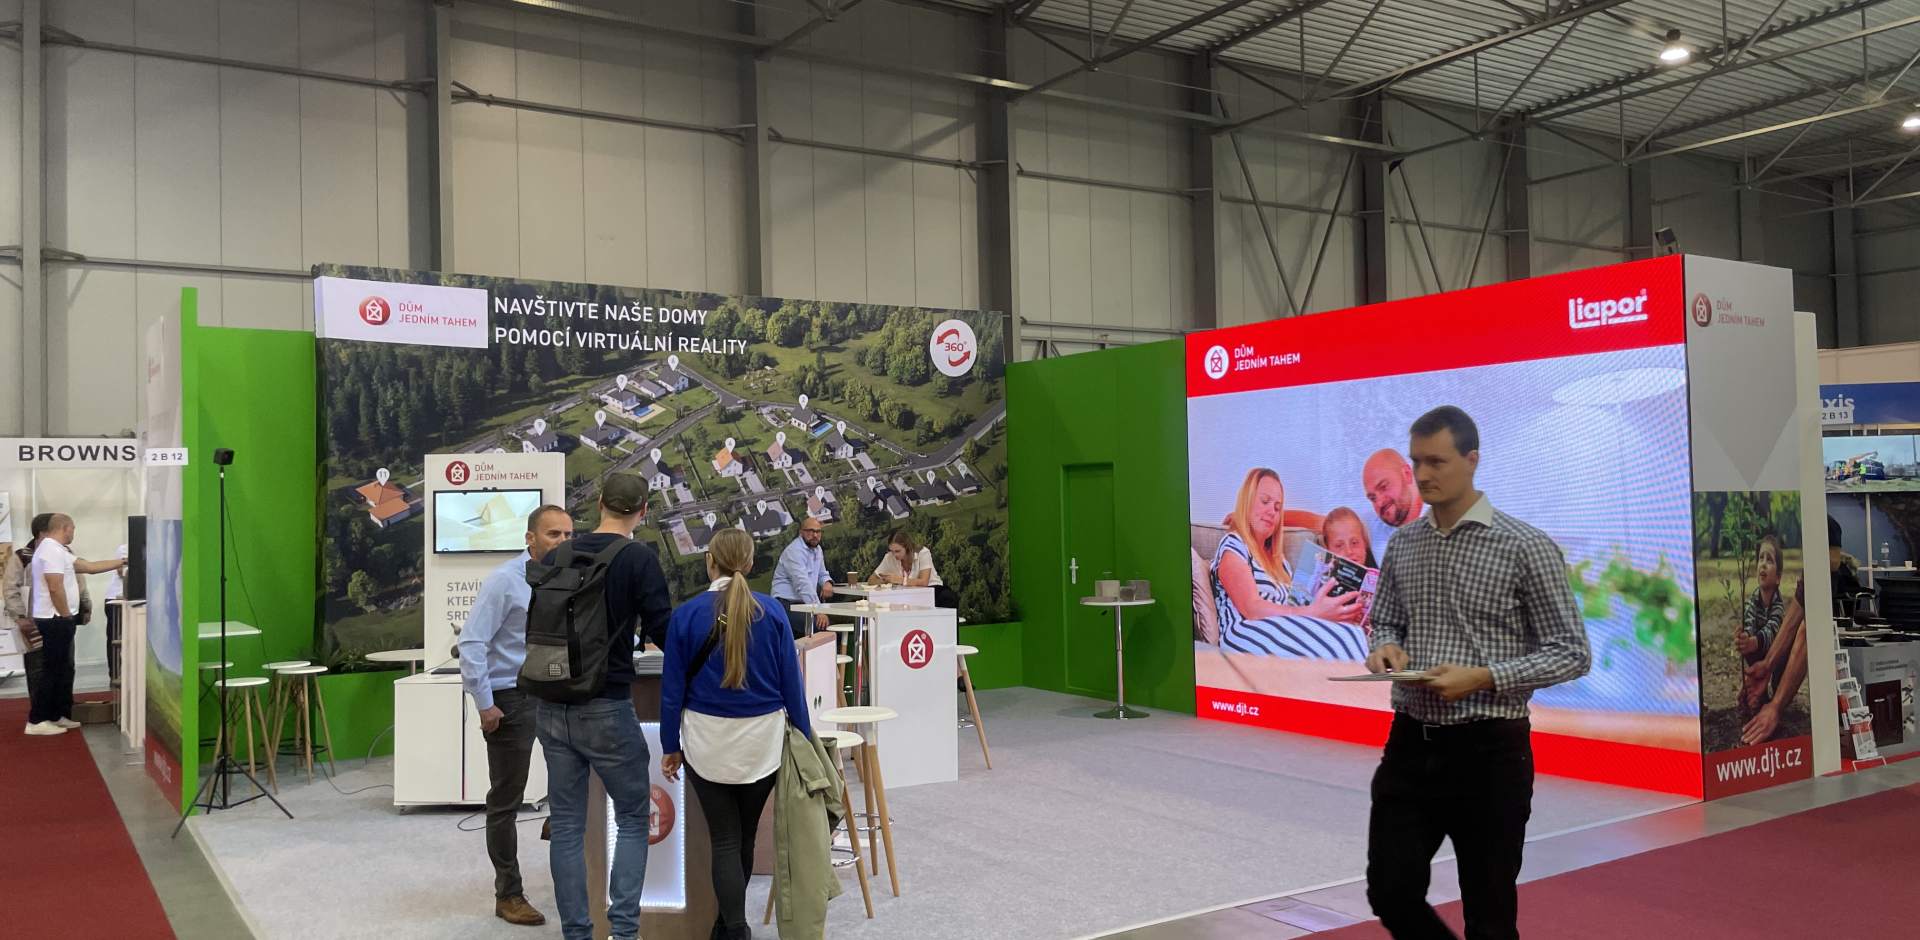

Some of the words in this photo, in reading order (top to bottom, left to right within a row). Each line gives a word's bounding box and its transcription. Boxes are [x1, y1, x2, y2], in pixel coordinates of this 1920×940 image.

[399, 300, 423, 313] DŮM
[494, 295, 599, 319] NAVŠTIVTE
[605, 302, 653, 322] NAŠE
[659, 308, 708, 325] DOMY
[399, 313, 439, 325] JEDNÍM
[442, 317, 477, 328] TAHEM
[494, 327, 571, 347] POMOCÍ
[576, 330, 673, 351] VIRTUÁLNÍ
[678, 337, 748, 354] REALITY
[1234, 344, 1255, 358] DŮM
[1234, 355, 1268, 371] JEDNÍM
[1270, 353, 1301, 366] TAHEM
[1829, 412, 1836, 420] B
[1839, 411, 1848, 420] 13
[18, 444, 136, 462] BROWNS
[151, 453, 158, 461] 2
[161, 453, 168, 461] B
[172, 452, 183, 461] 12
[475, 462, 494, 472] DŮM
[475, 471, 507, 481] JEDNÍM
[510, 472, 539, 480] TAHEM
[1212, 699, 1260, 716] www.djt.cz
[1716, 746, 1802, 783] www.djt.cz
